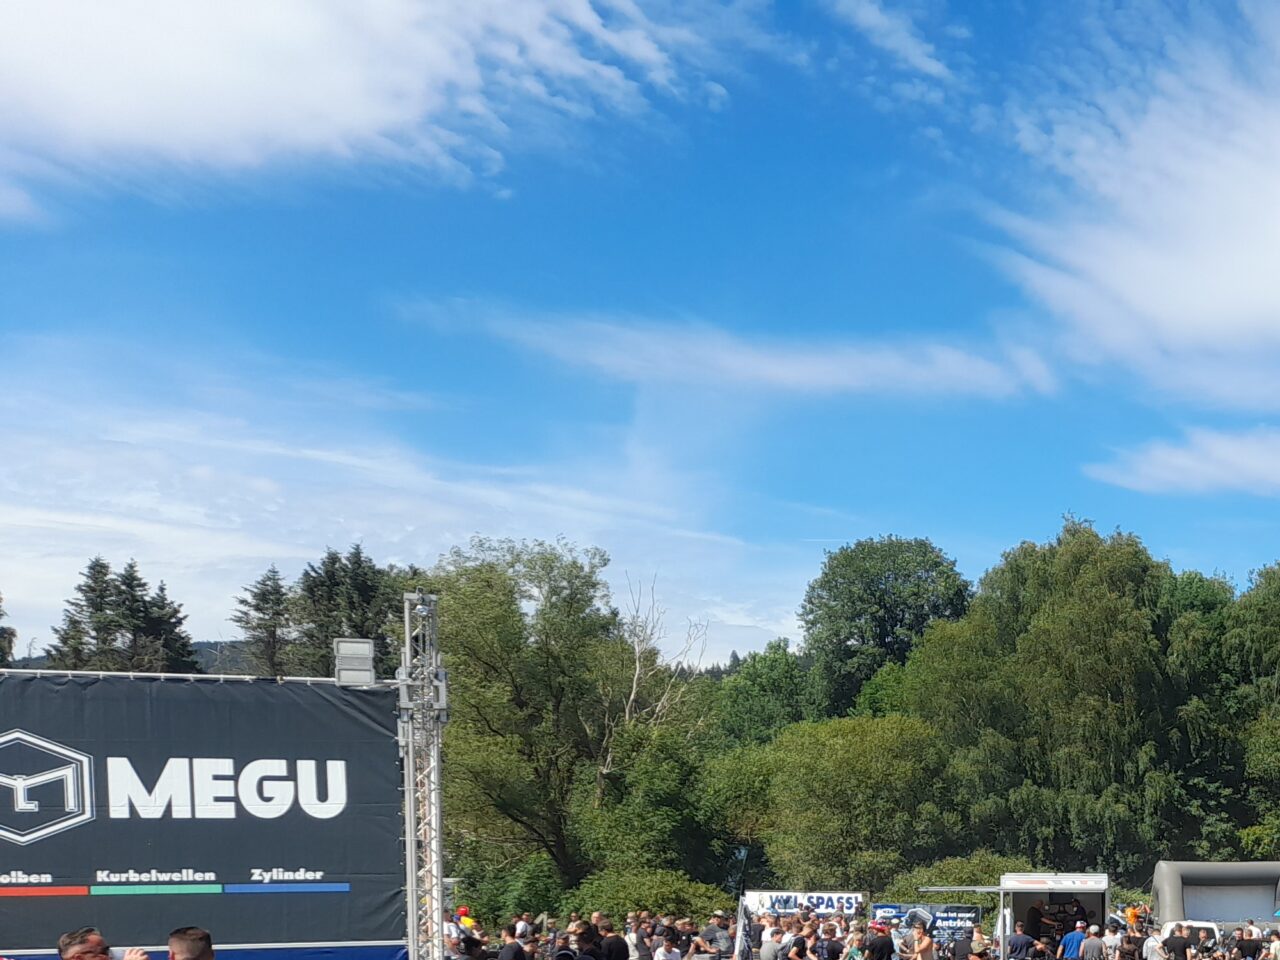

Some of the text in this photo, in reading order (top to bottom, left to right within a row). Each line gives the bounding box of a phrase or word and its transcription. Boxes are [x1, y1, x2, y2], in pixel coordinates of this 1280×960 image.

[106, 757, 347, 819] MEGU
[0, 870, 53, 884] olben
[96, 869, 216, 882] Kurbelwellen
[251, 868, 324, 882] Zylinder
